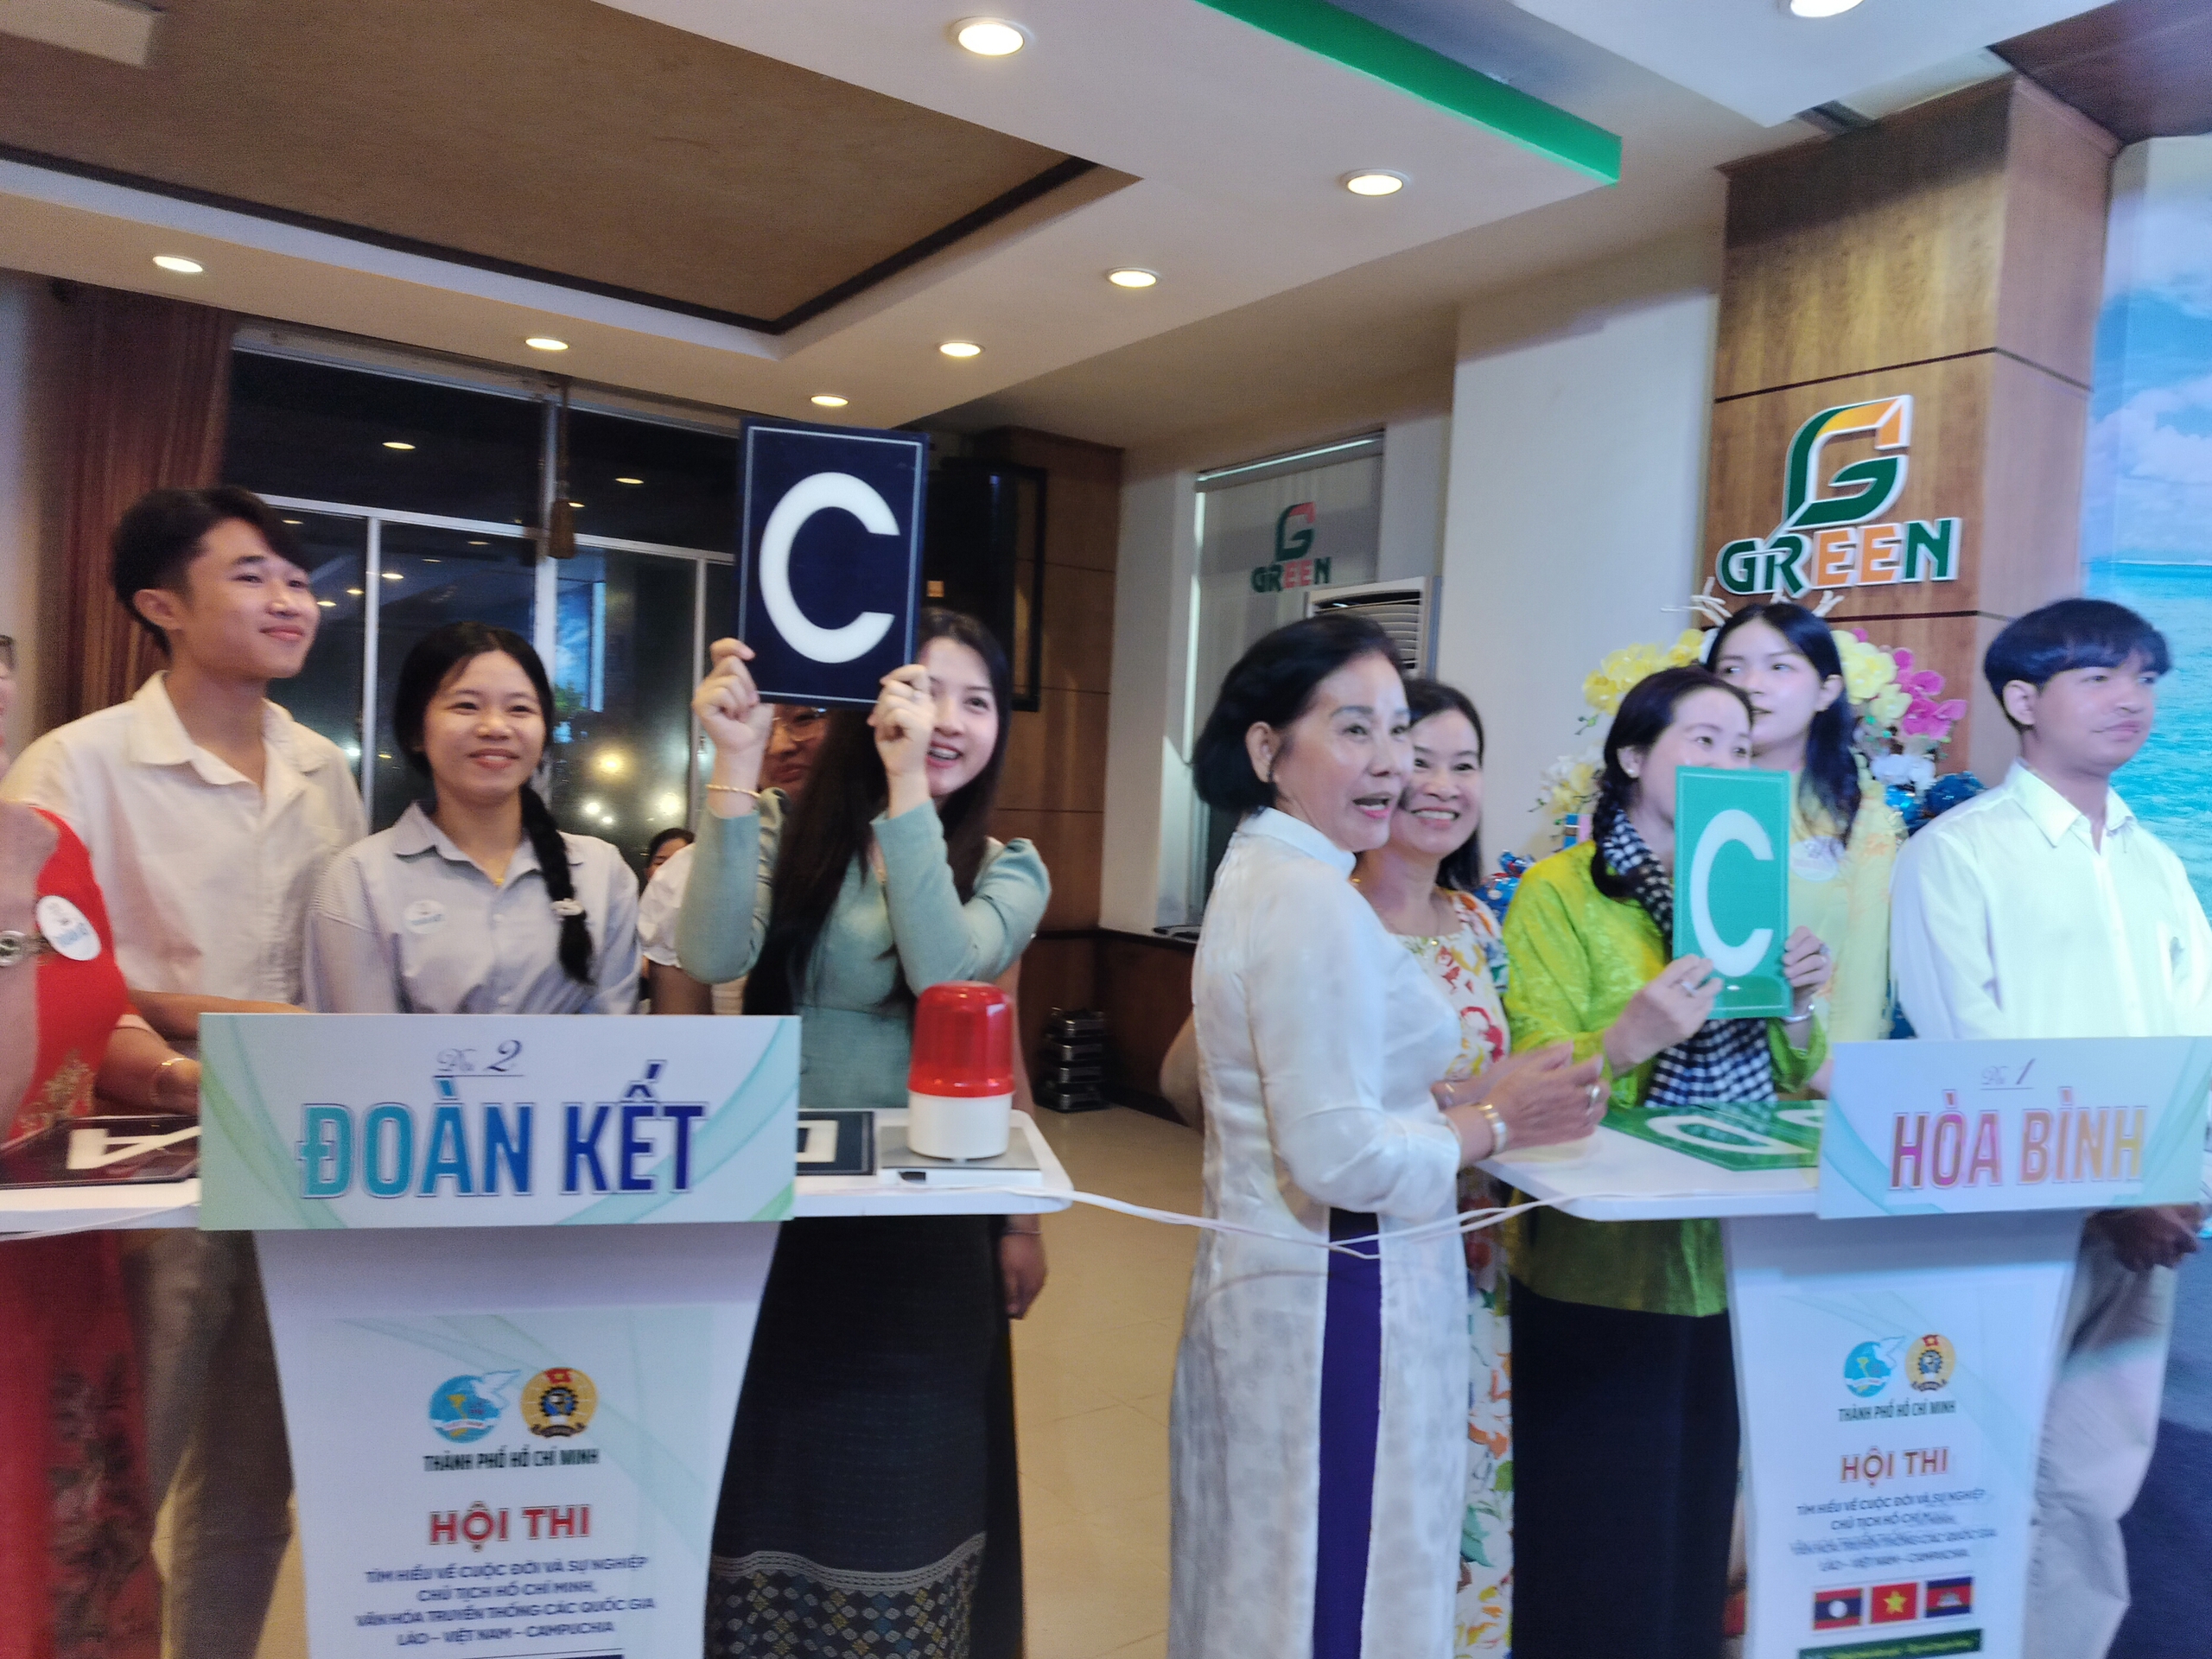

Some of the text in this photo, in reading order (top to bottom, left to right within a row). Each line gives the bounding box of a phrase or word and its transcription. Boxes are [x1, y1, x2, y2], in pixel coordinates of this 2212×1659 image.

[759, 472, 900, 664] C
[1250, 556, 1332, 593] GREEN
[1716, 517, 1961, 599] GREEN
[1690, 810, 1774, 977] C
[486, 1039, 522, 1071] 2
[295, 1059, 709, 1198] ĐOÀN KẾT
[1889, 1086, 2147, 1191] HÒA BÌNH
[423, 1450, 474, 1471] THÀNH
[1840, 1446, 1950, 1488] HỘI THI
[429, 1501, 591, 1553] HỘI THI
[459, 1562, 507, 1580] CUỘC
[524, 1621, 614, 1637] CAMPUCHIA
